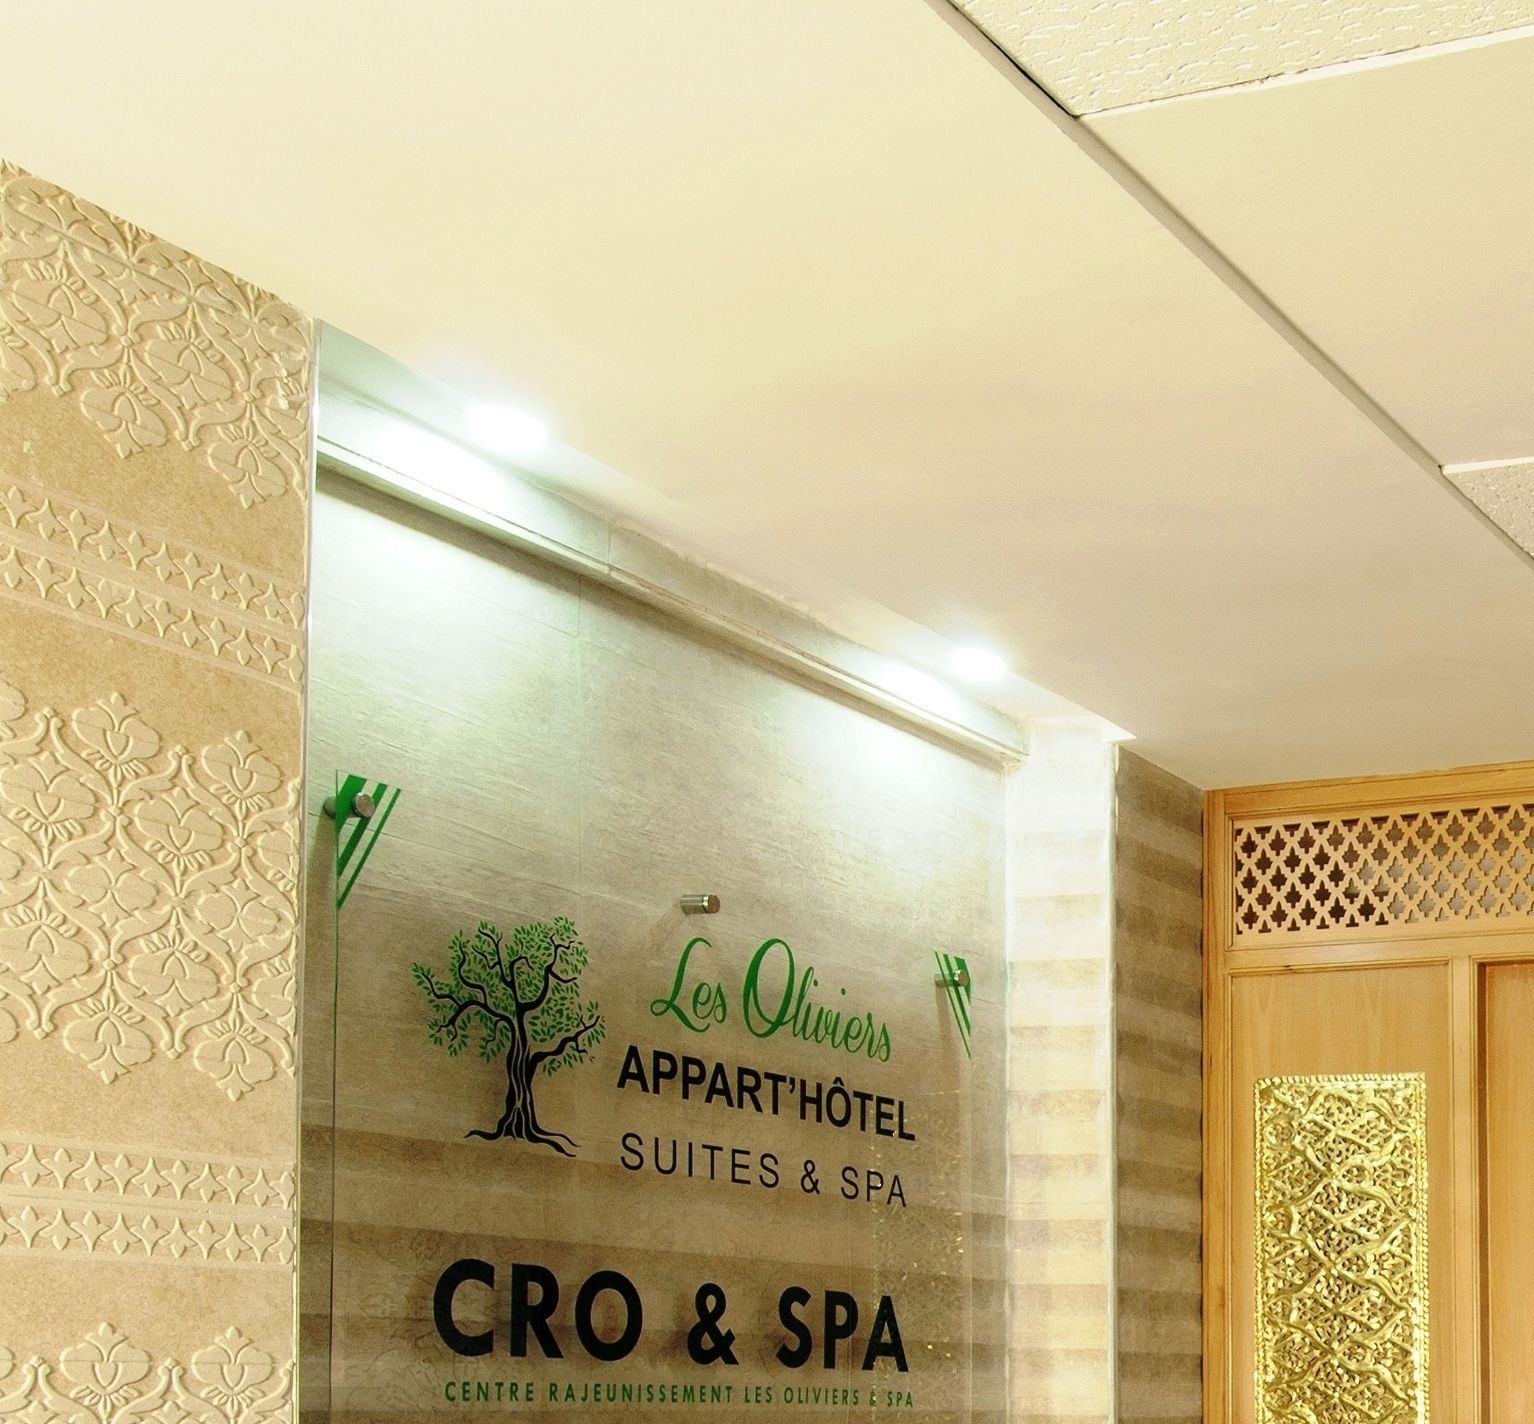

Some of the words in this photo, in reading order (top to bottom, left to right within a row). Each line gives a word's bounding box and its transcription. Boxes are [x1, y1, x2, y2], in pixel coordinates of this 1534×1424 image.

[651, 936, 728, 1033] Les
[742, 937, 892, 1063] Oliviers
[620, 1132, 780, 1189] SUITES
[800, 1159, 821, 1195] &
[840, 1165, 907, 1208] SPA
[432, 1257, 644, 1362] CRO
[686, 1281, 740, 1366] &
[775, 1285, 910, 1374] SPA
[444, 1381, 535, 1403] CENTRE
[548, 1382, 734, 1404] RAJEUNISSEMENT
[744, 1385, 773, 1405] LES
[783, 1386, 860, 1406] OLIVIERS
[868, 1390, 878, 1407] &
[886, 1391, 914, 1408] SPA
